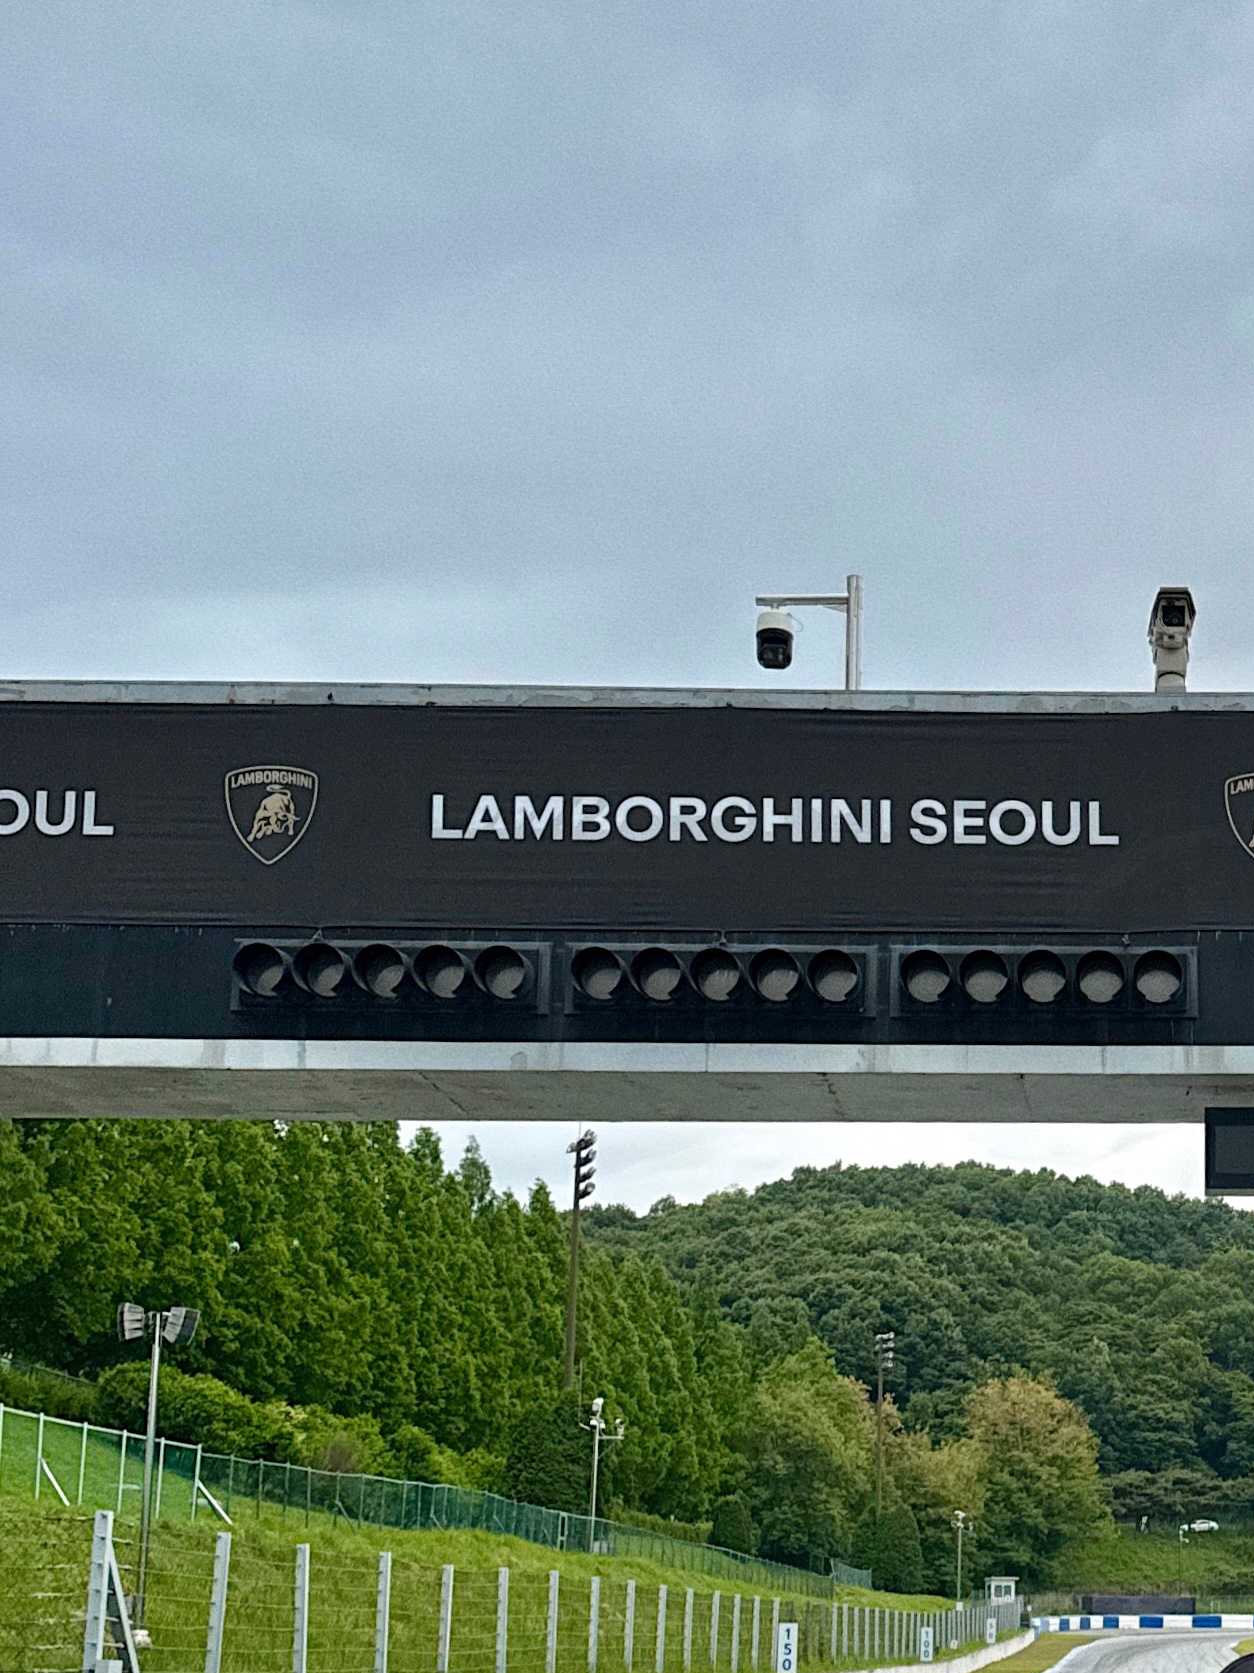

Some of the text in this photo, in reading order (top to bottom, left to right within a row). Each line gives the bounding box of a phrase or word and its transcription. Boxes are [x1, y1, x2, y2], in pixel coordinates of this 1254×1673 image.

[230, 770, 313, 789] LAMBORGHINI
[0, 789, 114, 836] OUL
[431, 794, 1120, 846] LAMBORGHINI SEOUL
[782, 1628, 793, 1672] 150
[923, 1631, 931, 1659] 100
